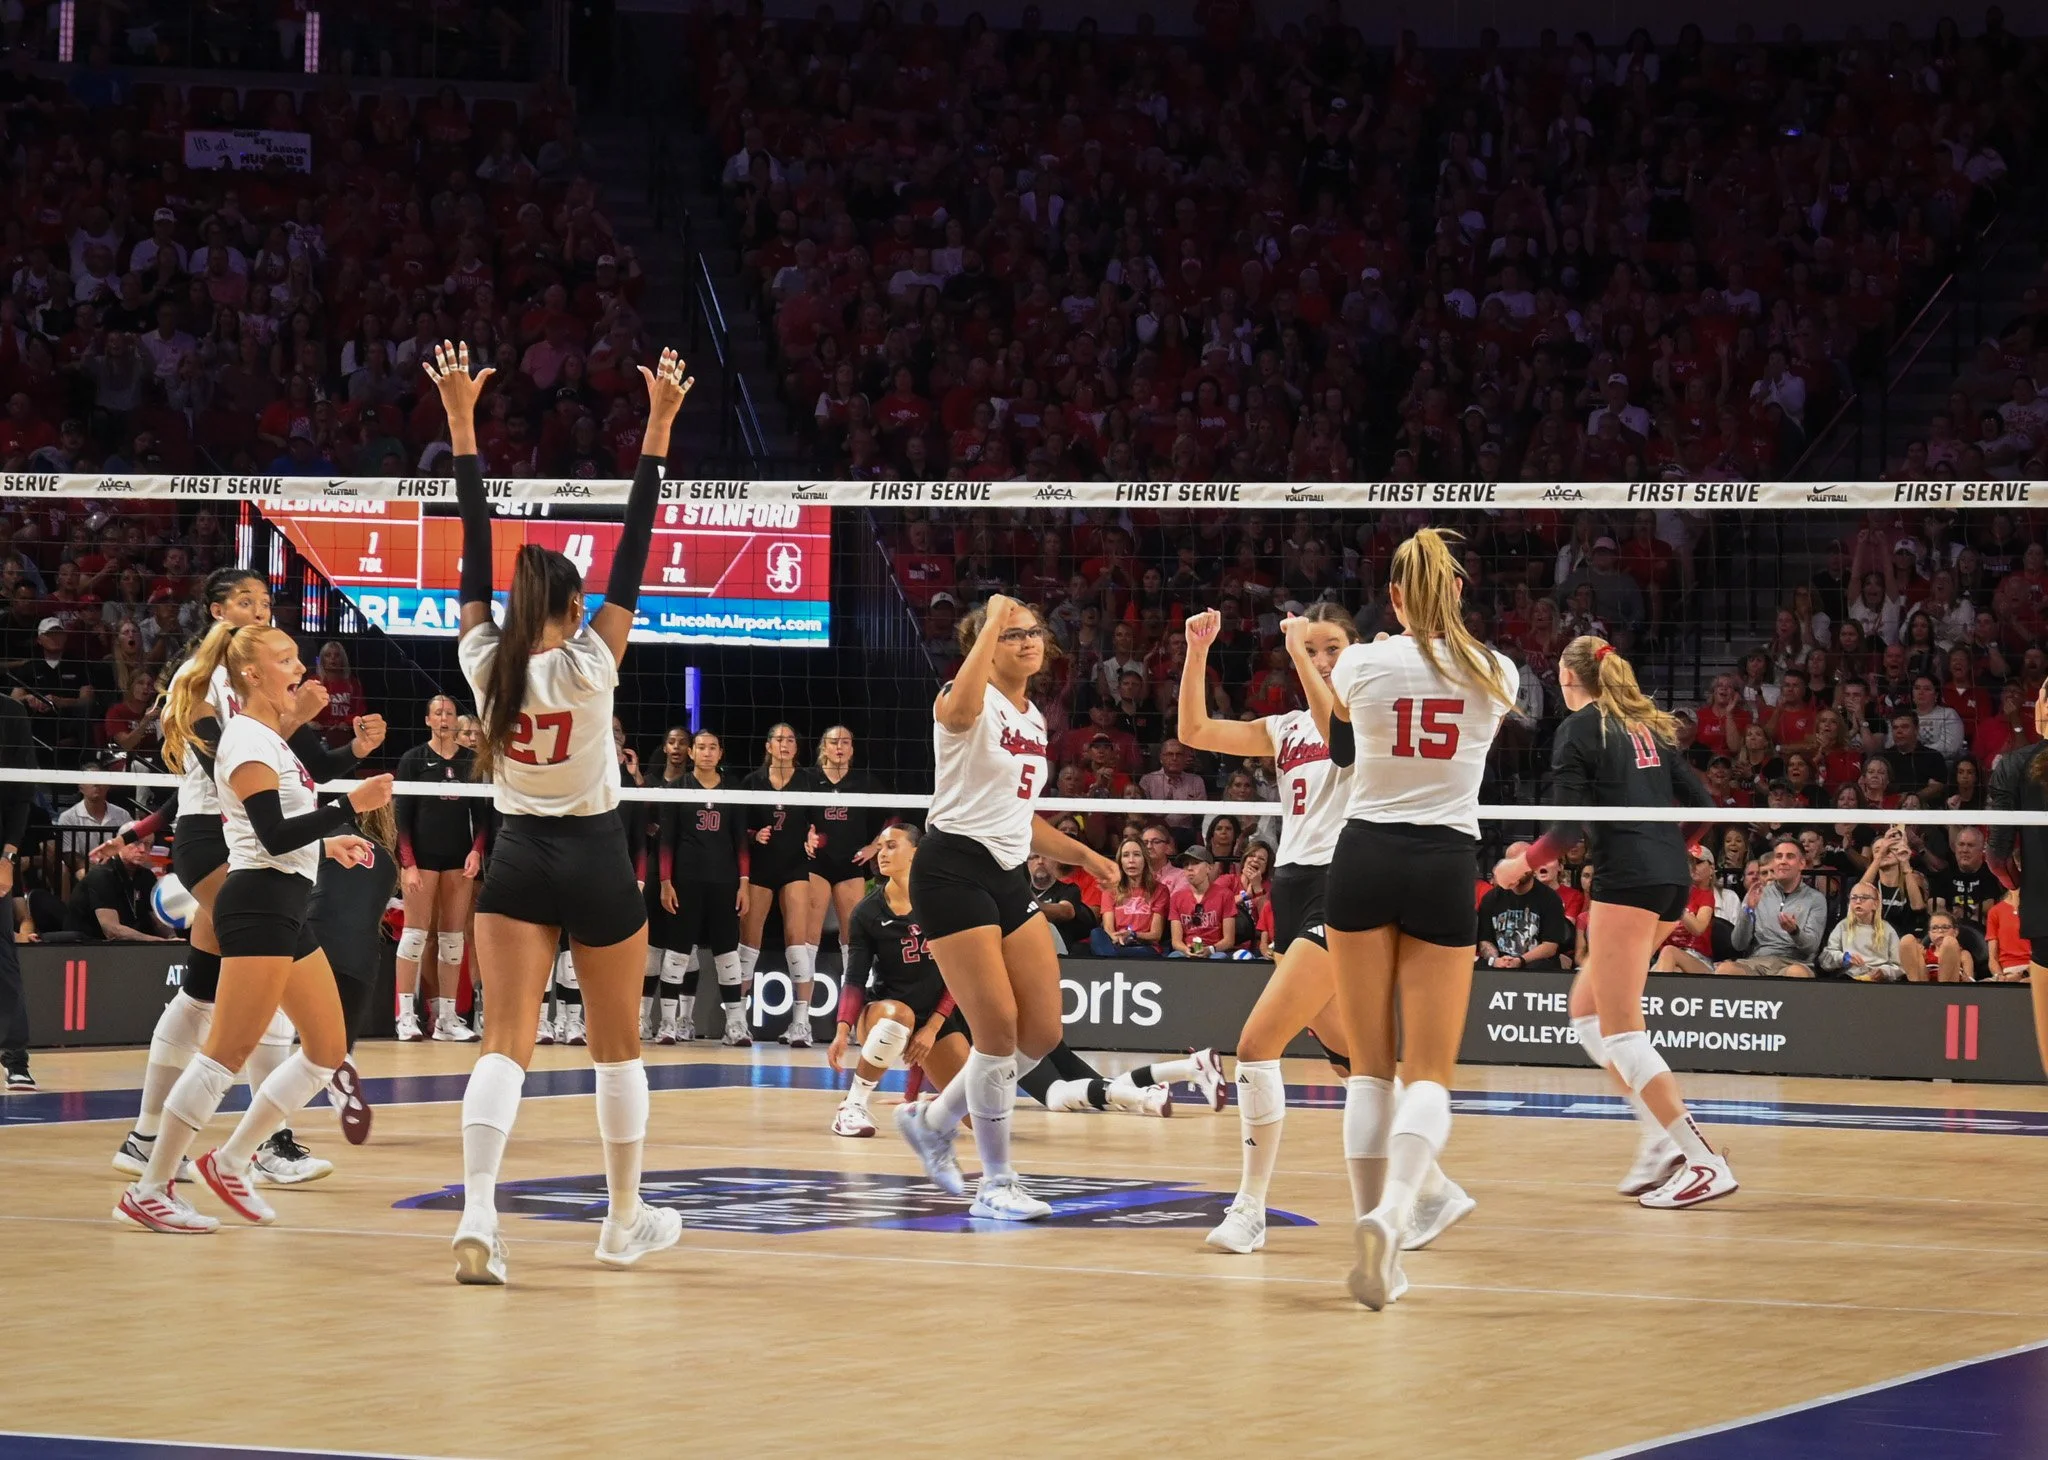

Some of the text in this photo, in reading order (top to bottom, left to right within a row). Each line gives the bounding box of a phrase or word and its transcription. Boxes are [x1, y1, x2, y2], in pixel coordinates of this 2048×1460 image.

[4, 475, 60, 492] SERVE
[170, 477, 283, 495] FIRST SERVE
[323, 488, 358, 496] VOLLEYBALL
[397, 479, 450, 496] FIRST
[690, 481, 750, 499] SERVE
[870, 483, 992, 500] FIRST SERVE
[1116, 484, 1241, 502] FIRST SERVE
[1368, 484, 1497, 502] FIRST SERVE
[1627, 484, 1760, 502] FIRST SERVE
[1894, 483, 2031, 502] FIRST SERVE
[791, 492, 828, 501] VOLLEYBALL
[1285, 494, 1324, 502] VOLLEYBALL
[1806, 494, 1847, 503] VOLLEYBALL
[682, 504, 800, 529] STANFORD
[368, 531, 378, 555] 1
[671, 541, 682, 565] 1
[660, 613, 822, 632] LincolnAirport.com
[499, 710, 573, 765] 27
[1391, 697, 1464, 760] 15
[1625, 720, 1661, 769] 11
[1017, 763, 1036, 800] 5
[1292, 778, 1306, 815] 2
[695, 809, 721, 832] 30
[773, 810, 787, 831] 7
[165, 965, 184, 986] AT
[1488, 991, 1518, 1011] AT
[1523, 992, 1567, 1013] THE
[1670, 997, 1704, 1017] OF
[1710, 998, 1784, 1020] EVERY
[1487, 1024, 1787, 1052] VOLLEYB AMPIONSHIP
